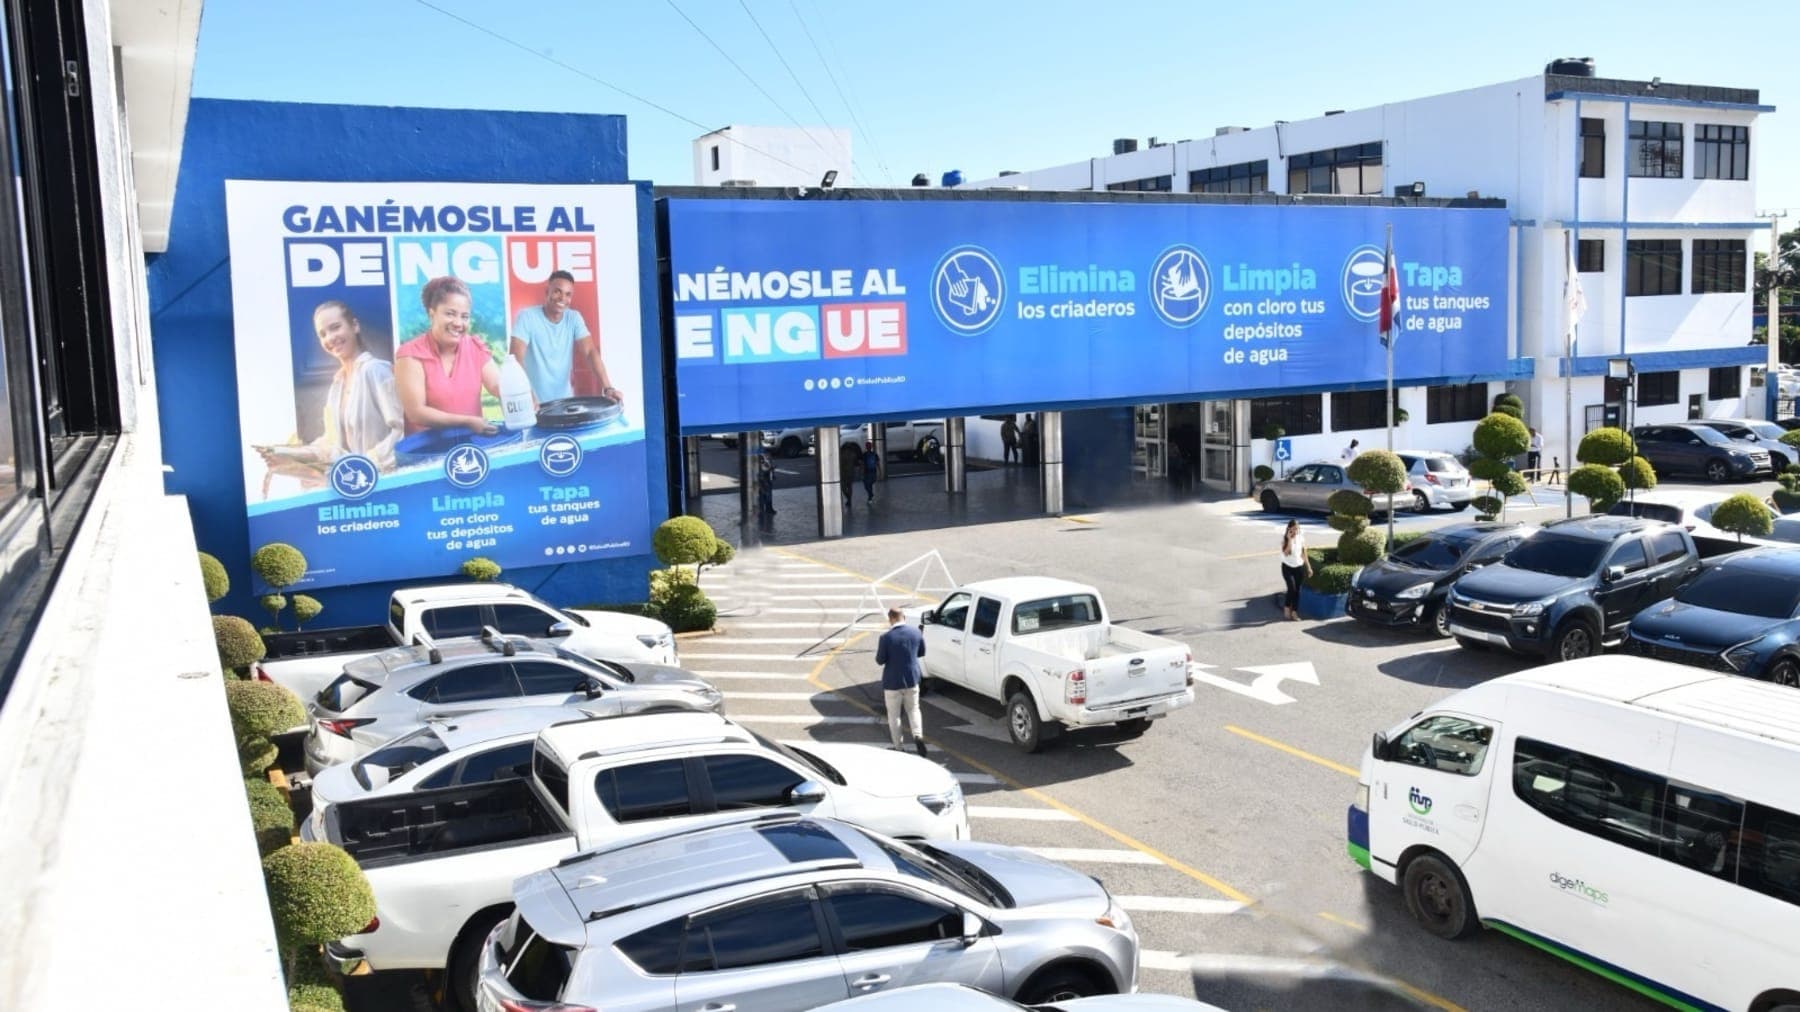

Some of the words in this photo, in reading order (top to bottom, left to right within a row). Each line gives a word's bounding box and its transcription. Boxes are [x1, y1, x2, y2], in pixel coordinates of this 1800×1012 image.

[283, 199, 536, 233] GANÉMOSLE
[546, 206, 595, 233] AL
[673, 266, 853, 301] NÉMOSLE
[861, 268, 906, 296] AL
[1018, 264, 1135, 294] Elimina
[1222, 263, 1317, 296] Limpia
[1402, 262, 1463, 291] Tapa
[1017, 301, 1045, 319] los
[1050, 300, 1135, 317] criaderos
[1223, 302, 1252, 316] con
[1257, 299, 1296, 315] cloro
[1301, 300, 1325, 314] tus
[1406, 296, 1429, 310] tus
[1433, 296, 1489, 312] tanques
[1223, 323, 1302, 342] depósitos
[1406, 315, 1424, 330] de
[1428, 317, 1462, 333] agua
[1223, 348, 1244, 364] de
[1250, 349, 1288, 366] agua
[432, 492, 505, 512] Limpia
[539, 484, 590, 502] Tapa
[318, 501, 400, 521] Elimina
[528, 504, 549, 514] tus
[551, 499, 600, 513] tanques
[318, 523, 336, 535] los
[340, 518, 400, 533] criaderos
[440, 515, 464, 527] con
[466, 511, 499, 525] cloro
[541, 514, 556, 526] de
[559, 513, 589, 526] agua
[427, 529, 447, 541] tus
[451, 524, 514, 540] depósitos
[446, 539, 462, 551] de
[466, 536, 497, 551] agua
